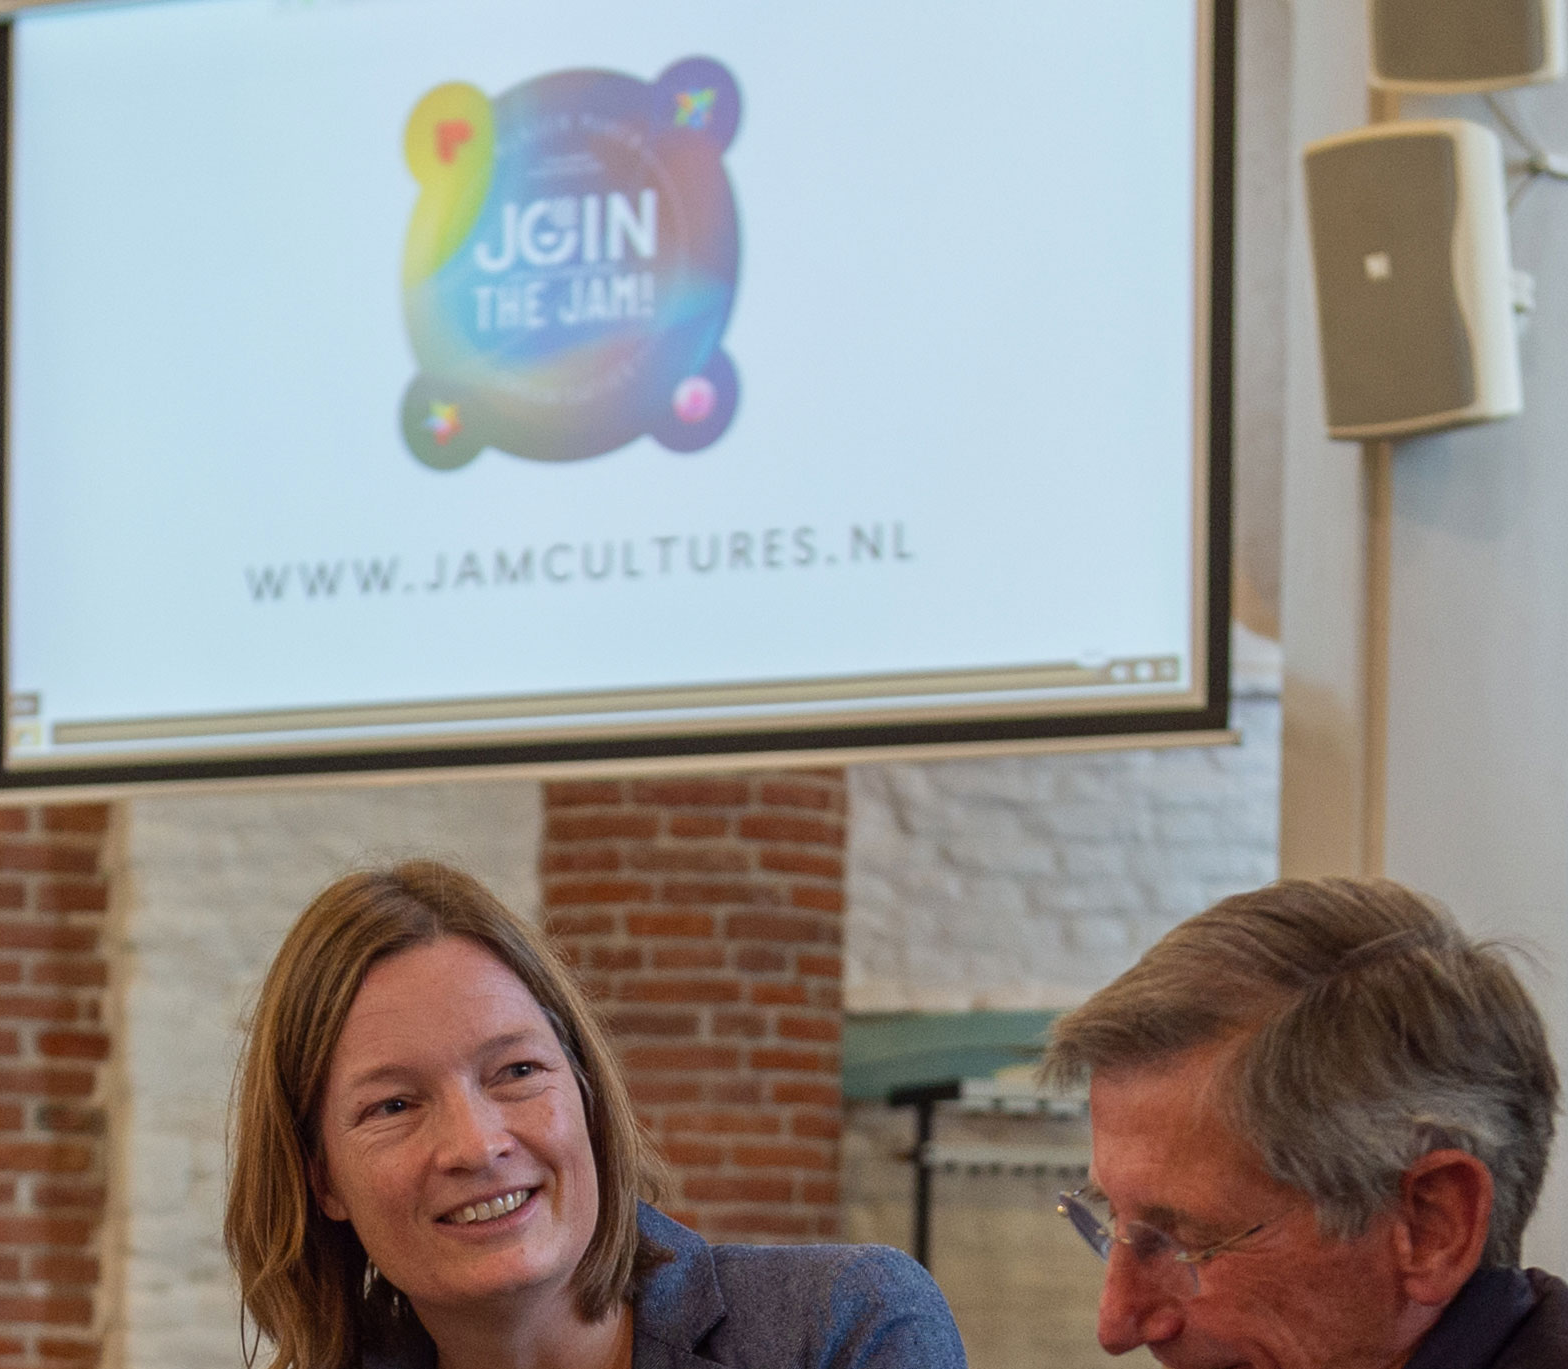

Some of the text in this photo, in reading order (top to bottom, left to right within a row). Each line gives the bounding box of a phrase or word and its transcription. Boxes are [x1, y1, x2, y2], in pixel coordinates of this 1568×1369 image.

[474, 188, 658, 273] JOIN
[473, 272, 655, 332] THE JAM!
[244, 521, 916, 602] WWW.JAMCULTURES.NL
